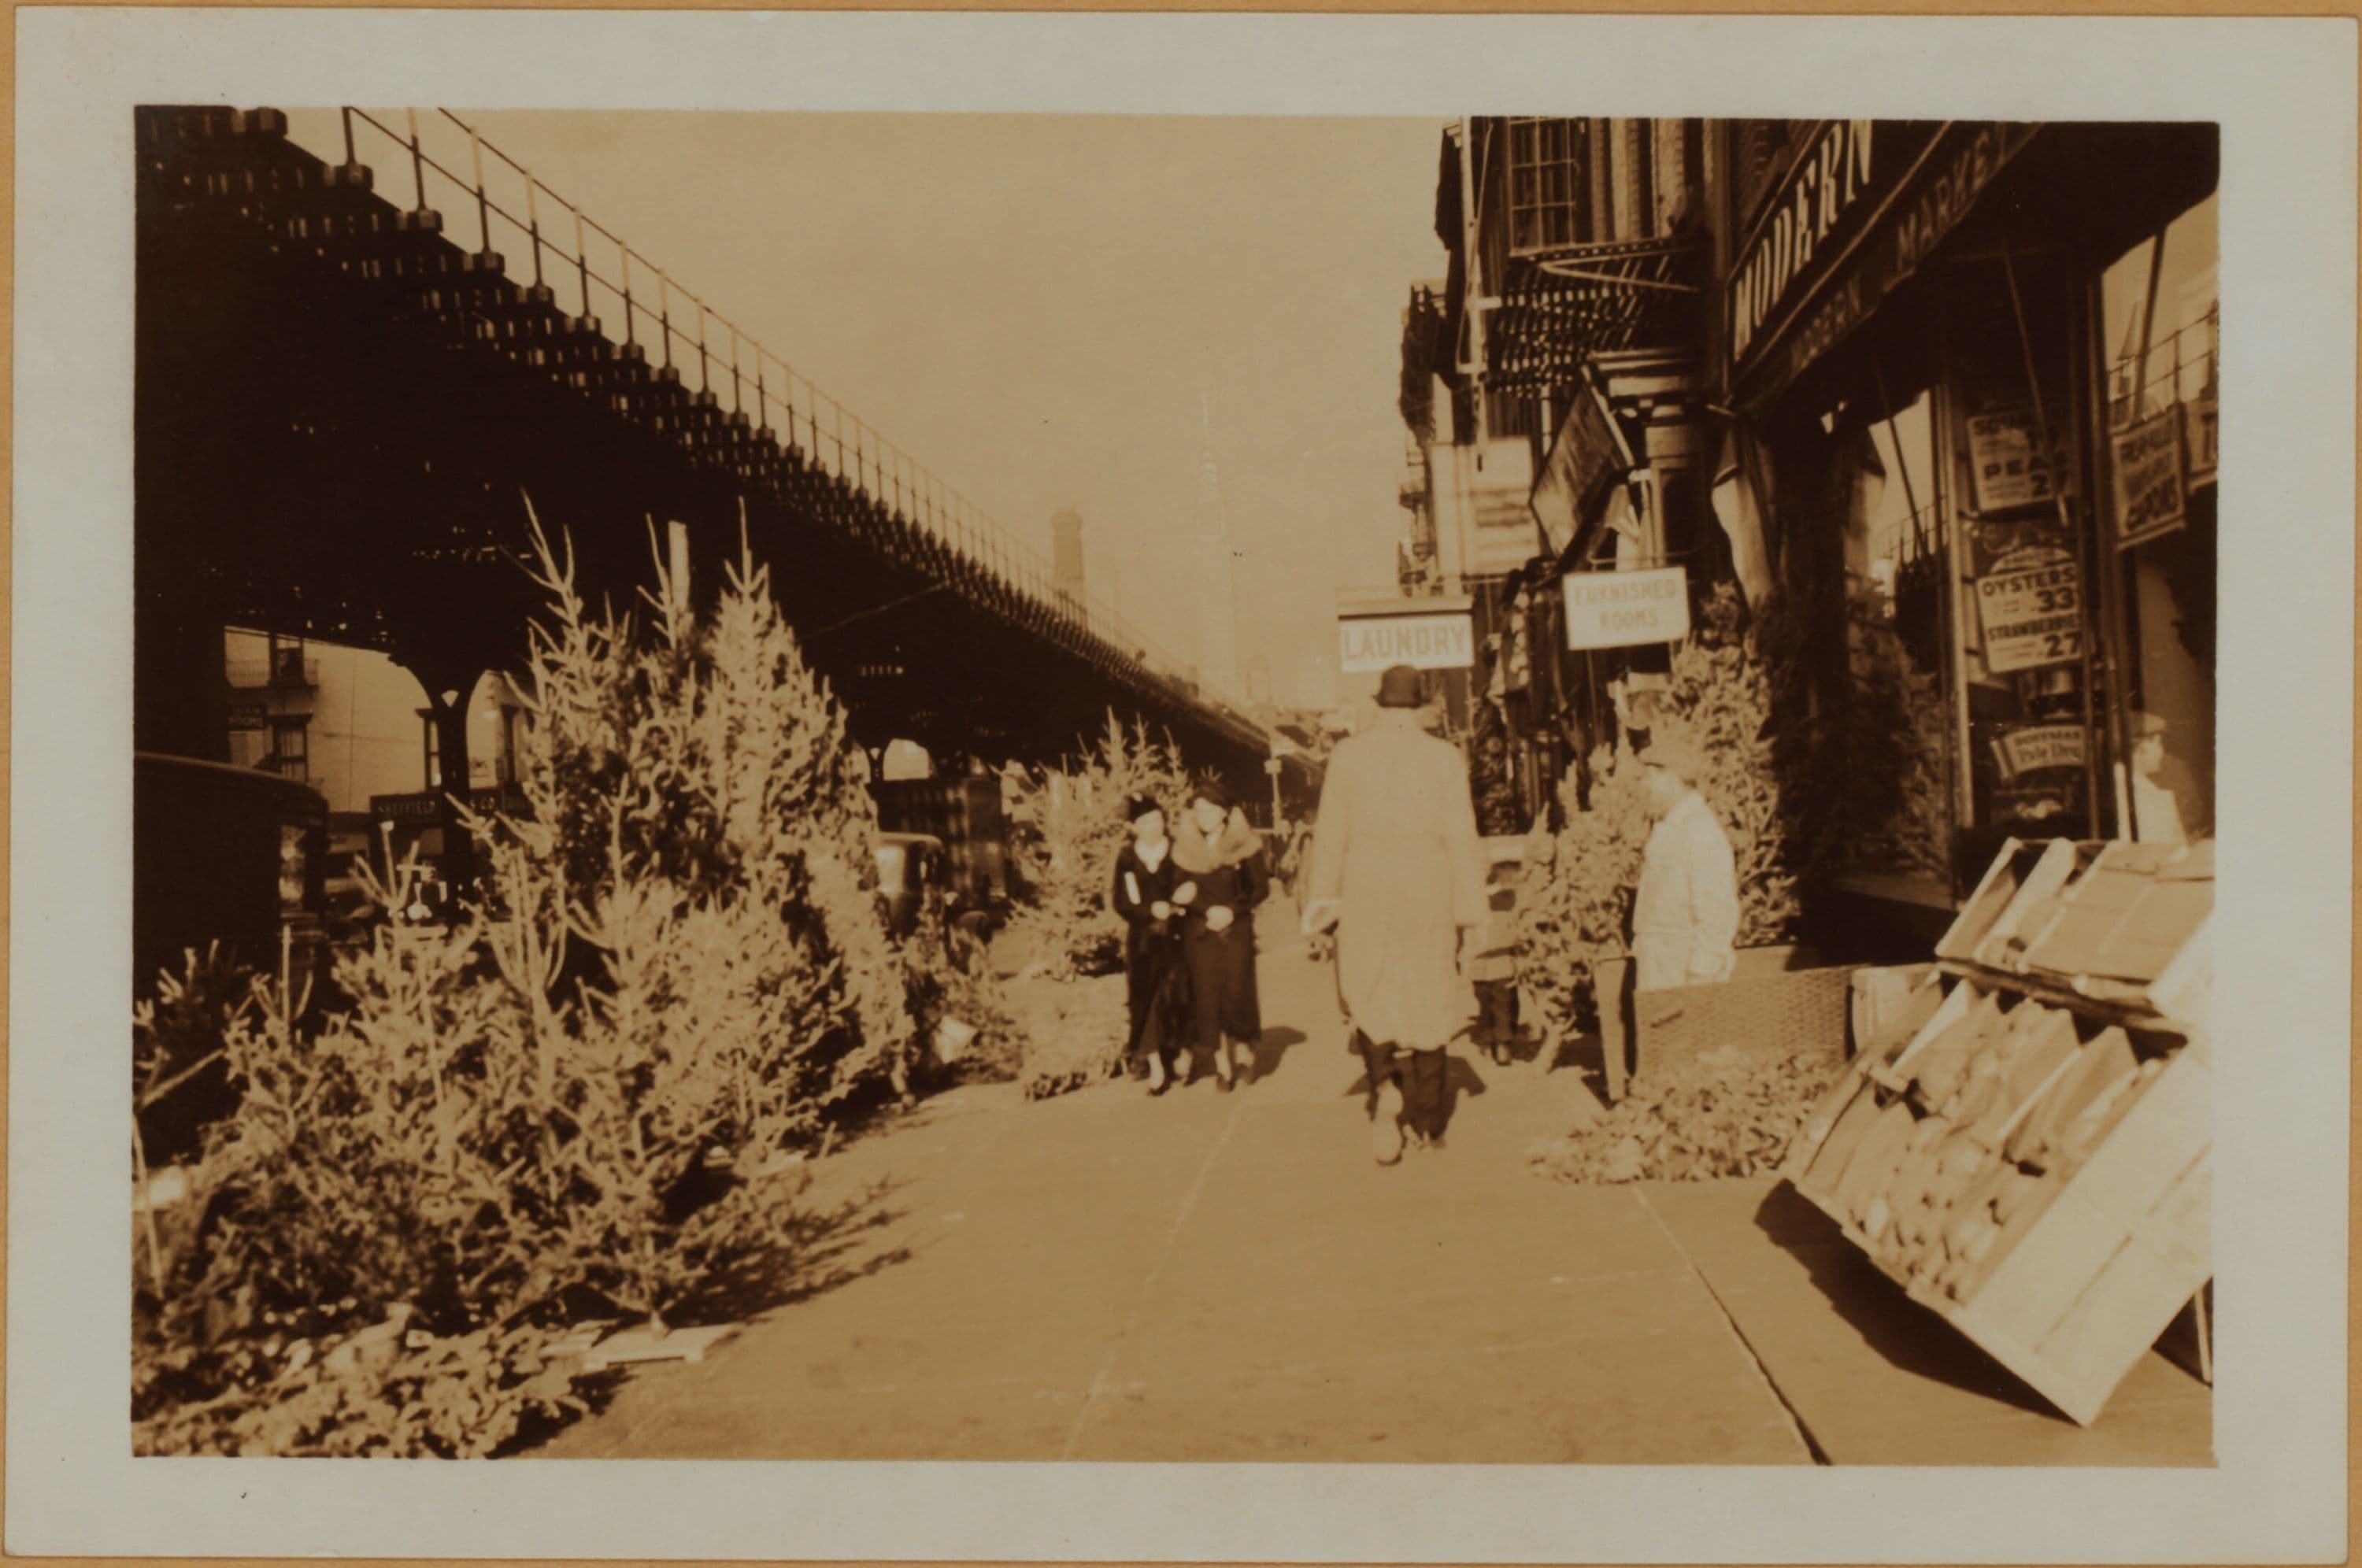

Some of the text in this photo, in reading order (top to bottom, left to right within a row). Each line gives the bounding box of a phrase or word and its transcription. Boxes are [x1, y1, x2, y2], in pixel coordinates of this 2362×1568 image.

[1734, 120, 1870, 362] MODERN
[1574, 579, 1676, 605] FURNISHED
[1982, 567, 2076, 597] OYSTERS
[2036, 586, 2075, 613] 33
[1599, 609, 1659, 631] ROOMS
[1343, 621, 1466, 660] LAUNDRY
[2044, 631, 2082, 658] 27
